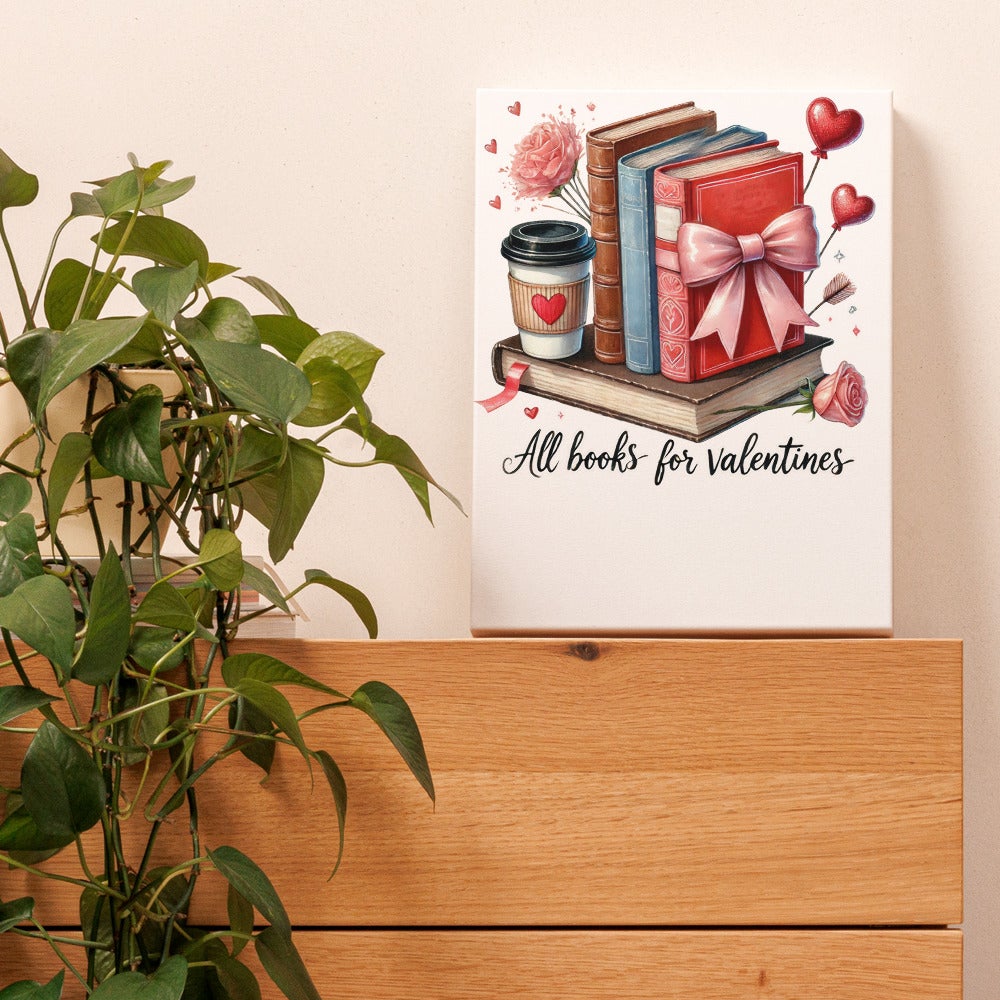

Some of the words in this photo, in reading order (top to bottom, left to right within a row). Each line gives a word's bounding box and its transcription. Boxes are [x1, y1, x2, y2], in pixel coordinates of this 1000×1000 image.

[502, 429, 563, 478] All
[567, 430, 648, 473] books
[654, 439, 698, 486] for
